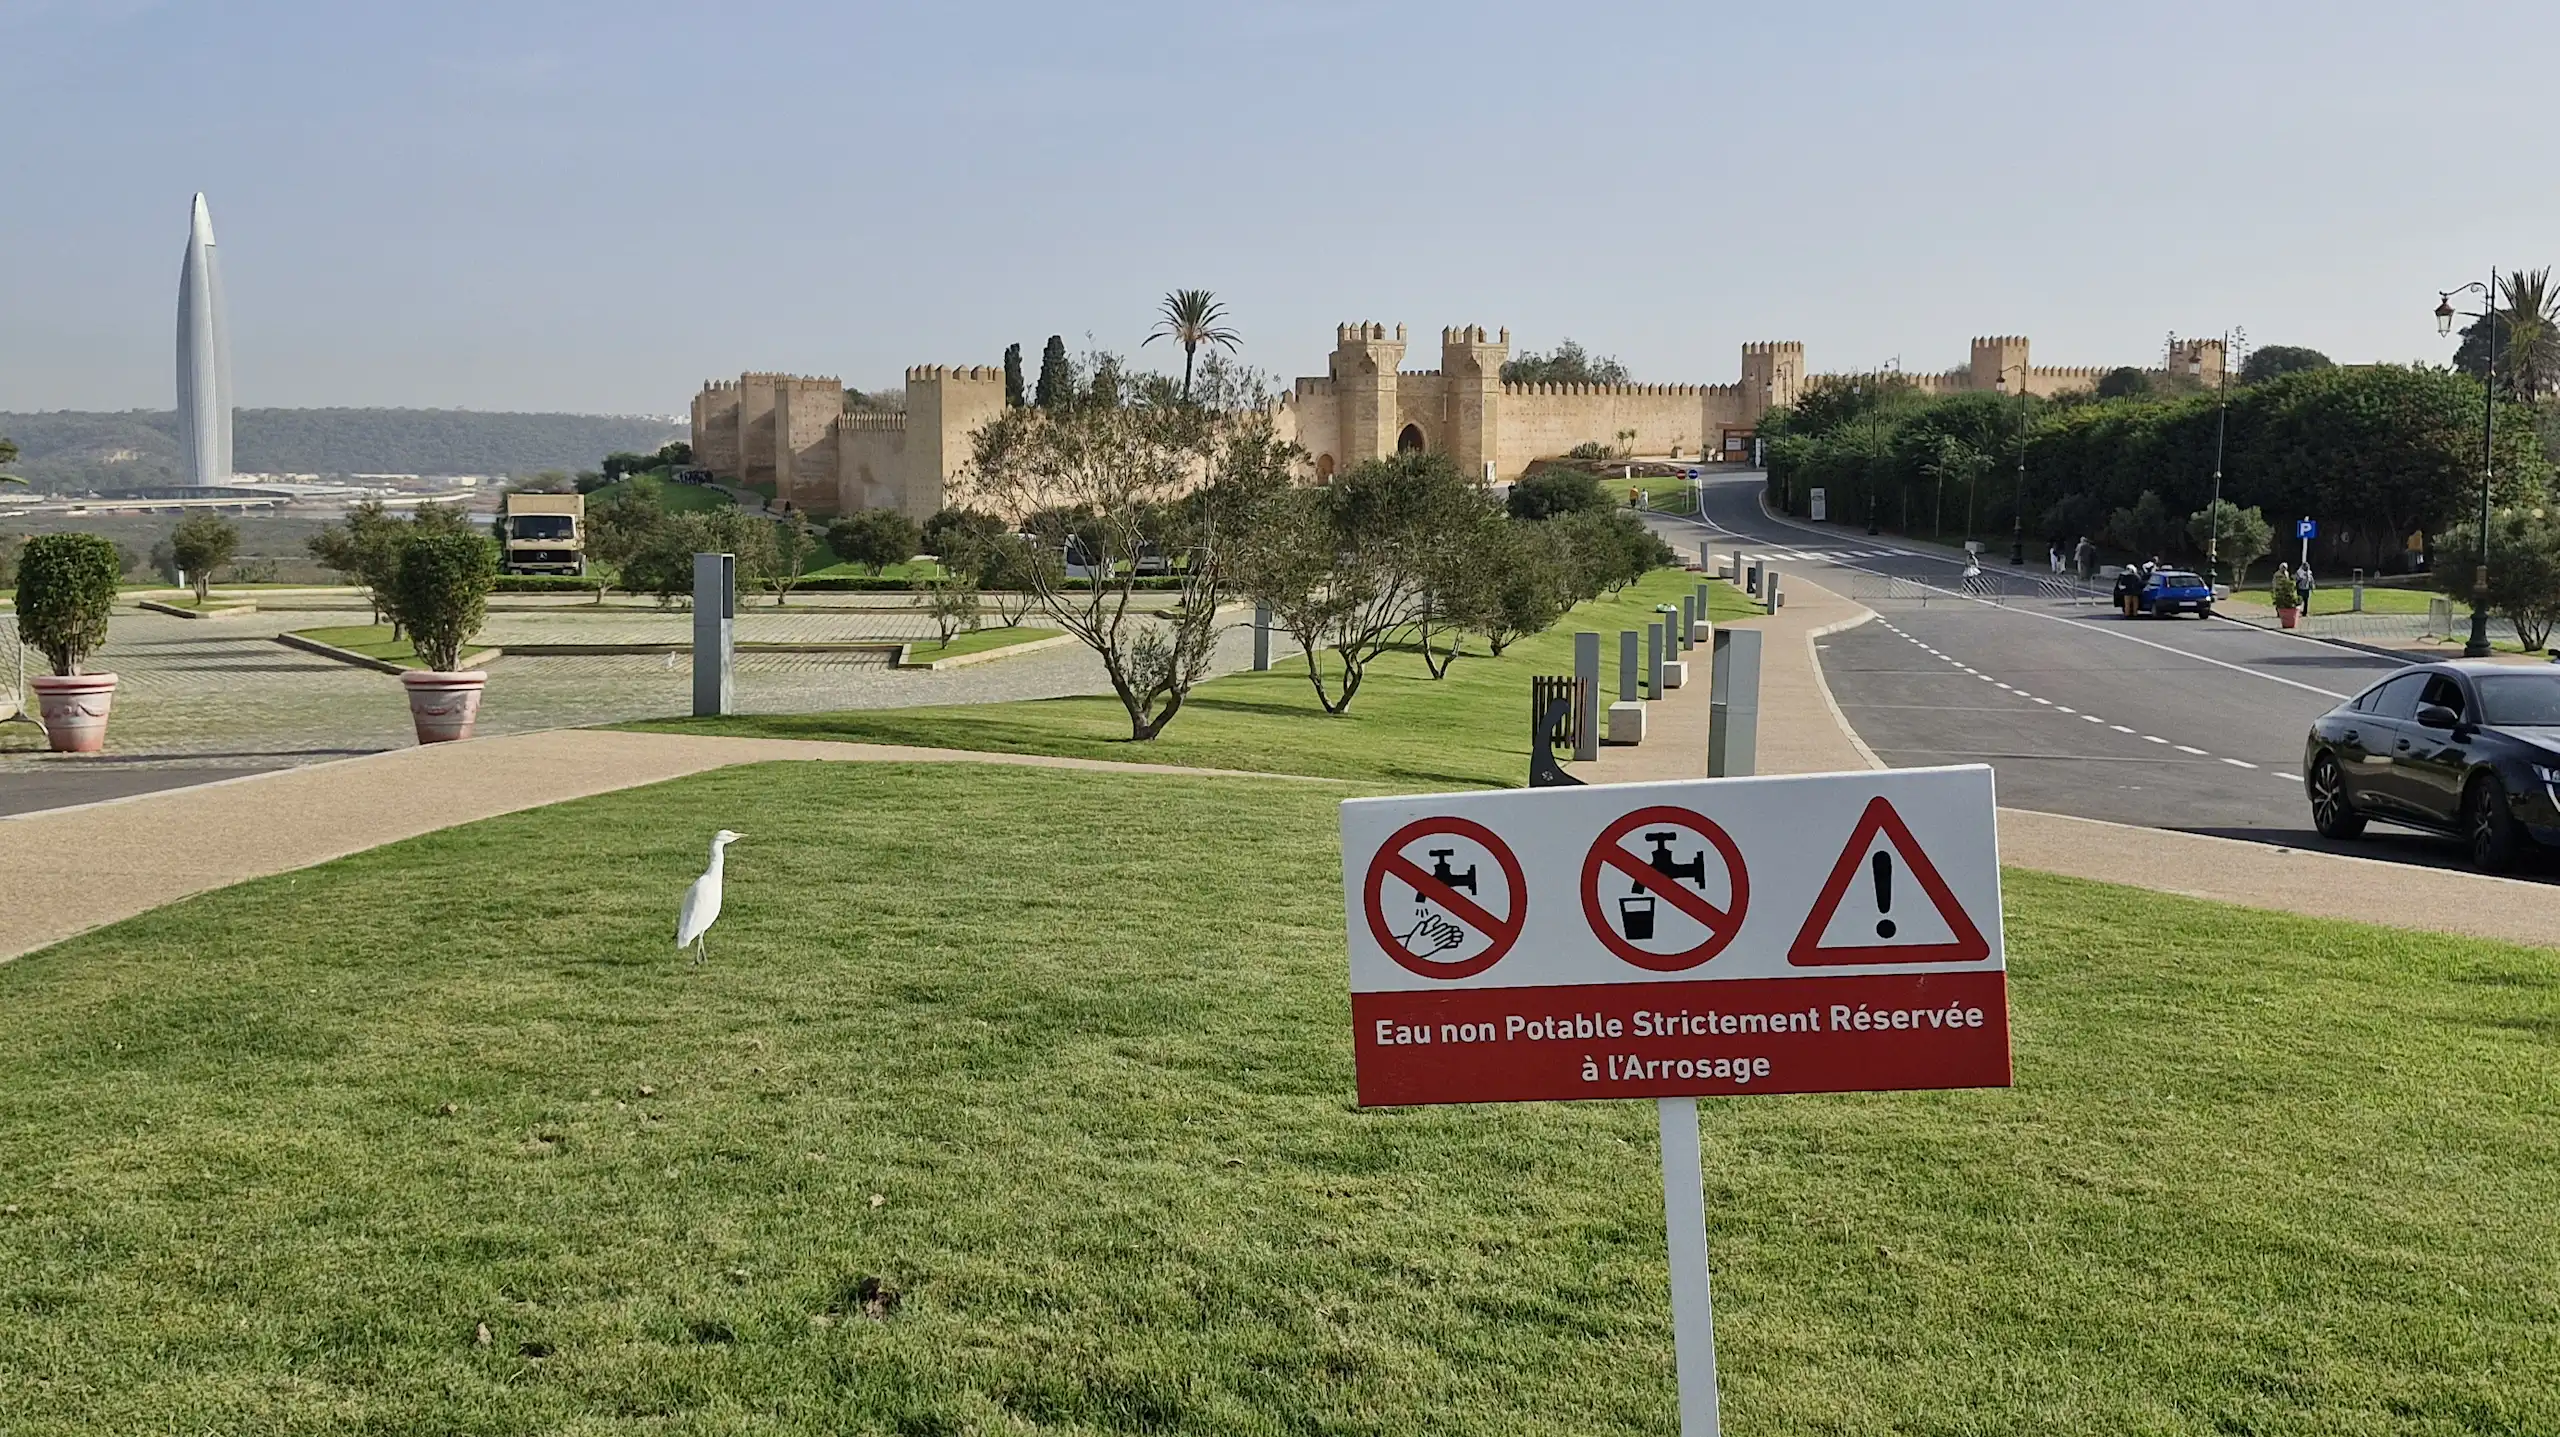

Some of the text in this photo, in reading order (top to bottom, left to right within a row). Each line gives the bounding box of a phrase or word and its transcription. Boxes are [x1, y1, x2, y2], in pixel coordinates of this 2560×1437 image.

[2300, 522, 2312, 536] P
[1376, 1001, 1984, 1045] Eau non Potable Strictement Réservée
[1581, 1054, 1770, 1084] à l'Arrosage
